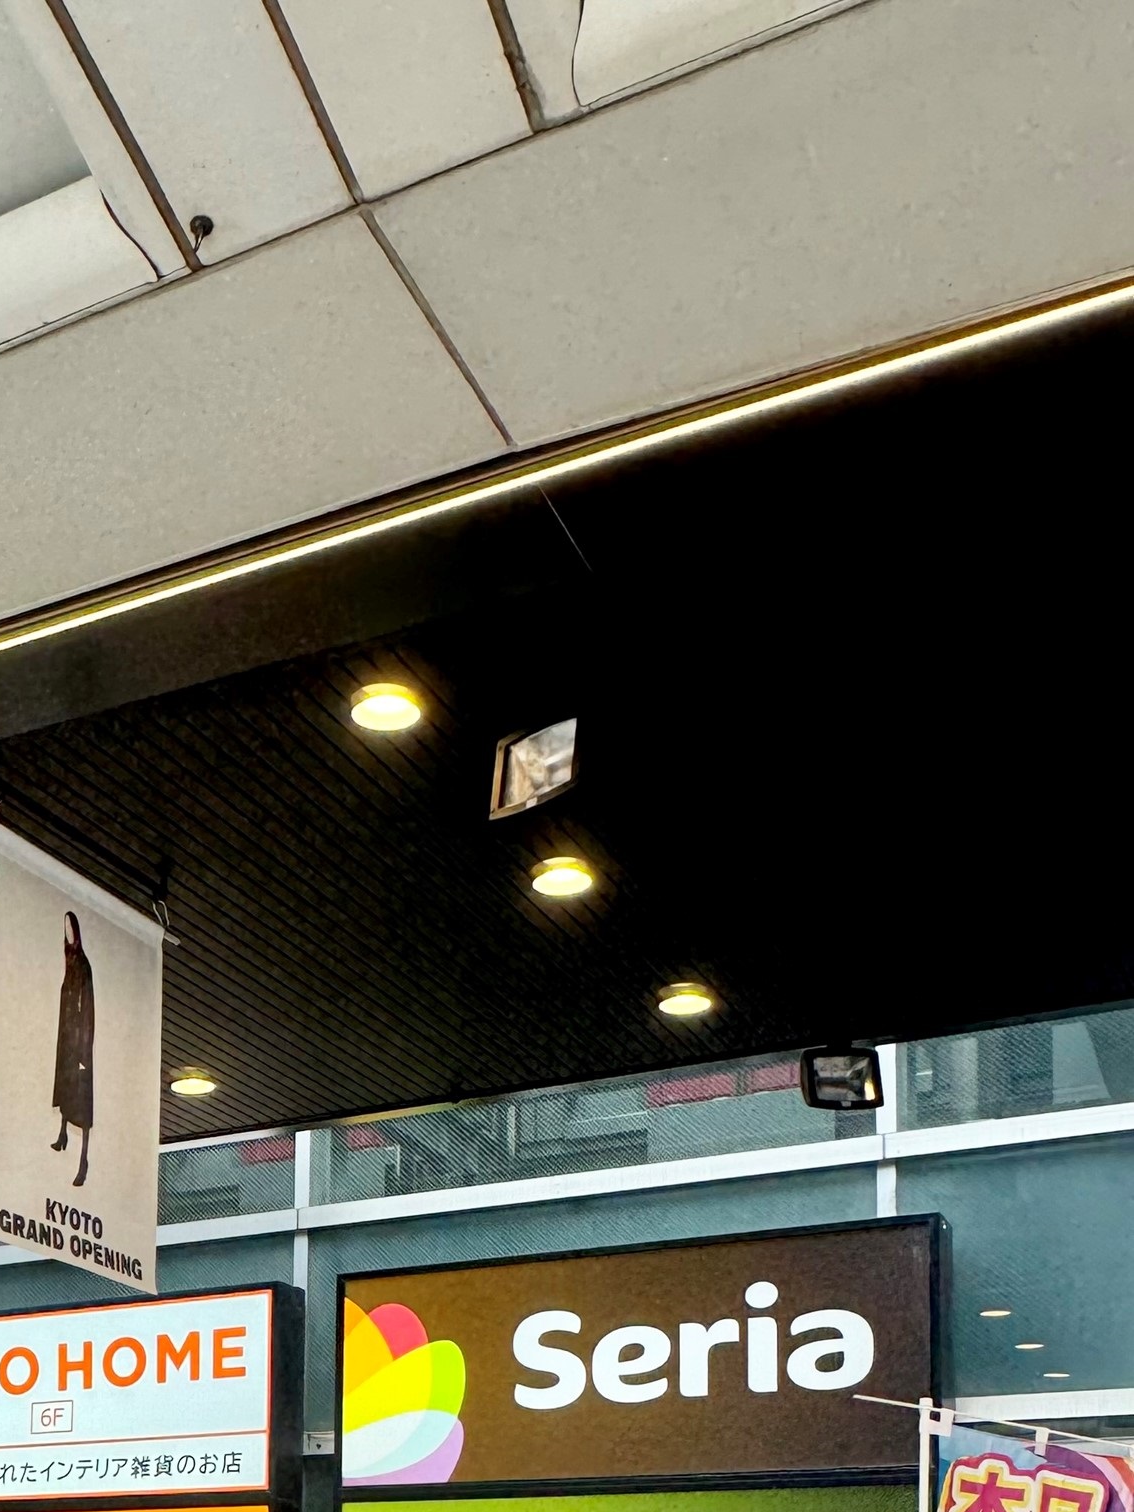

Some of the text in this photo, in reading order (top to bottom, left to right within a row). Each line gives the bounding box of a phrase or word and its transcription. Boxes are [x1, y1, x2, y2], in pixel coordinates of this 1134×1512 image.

[45, 1198, 103, 1240] KYOTO
[69, 1235, 143, 1281] OPENING
[57, 1326, 247, 1392] HOME
[512, 1281, 875, 1410] Seria
[39, 1406, 65, 1427] 6F
